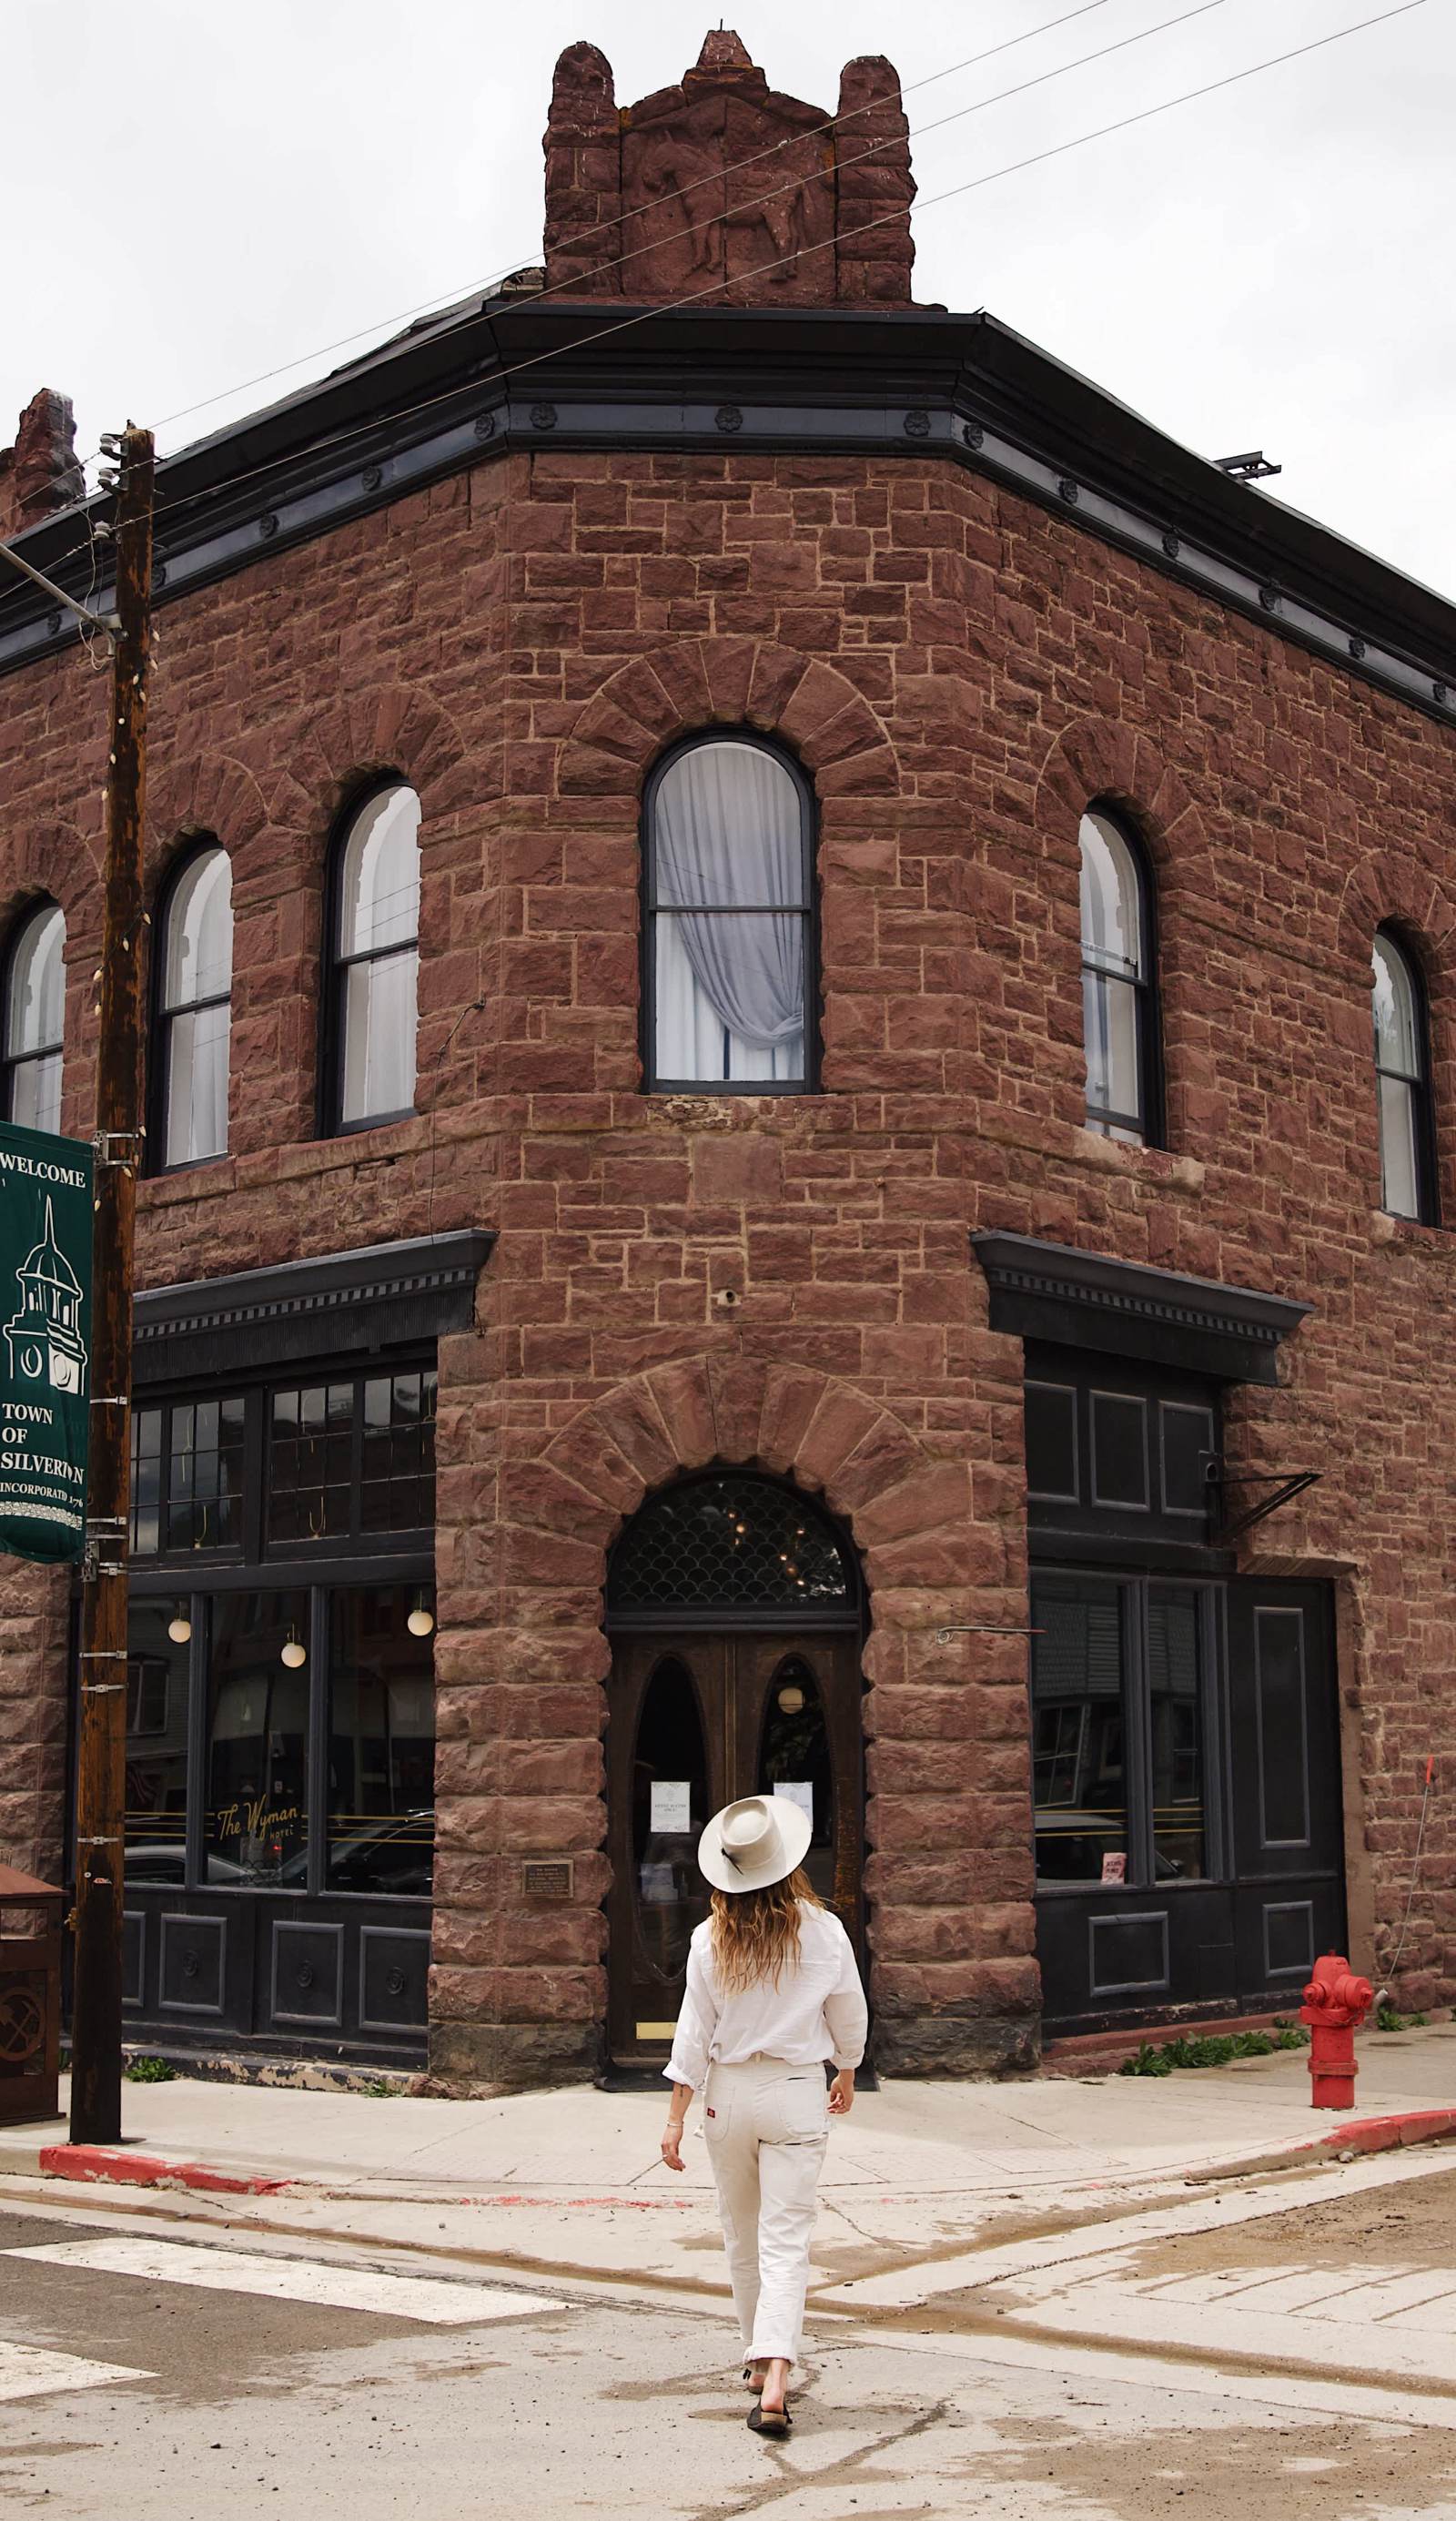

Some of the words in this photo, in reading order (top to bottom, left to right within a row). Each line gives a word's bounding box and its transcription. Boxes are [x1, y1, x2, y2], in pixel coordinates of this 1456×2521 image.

[0, 1152, 86, 1189] WELCOME
[2, 1402, 53, 1425] TOWN
[2, 1427, 27, 1443] OF
[0, 1482, 68, 1502] INCORPORATD
[217, 1804, 241, 1841] The
[243, 1793, 298, 1841] Wyman
[270, 1828, 293, 1840] HOTEL
